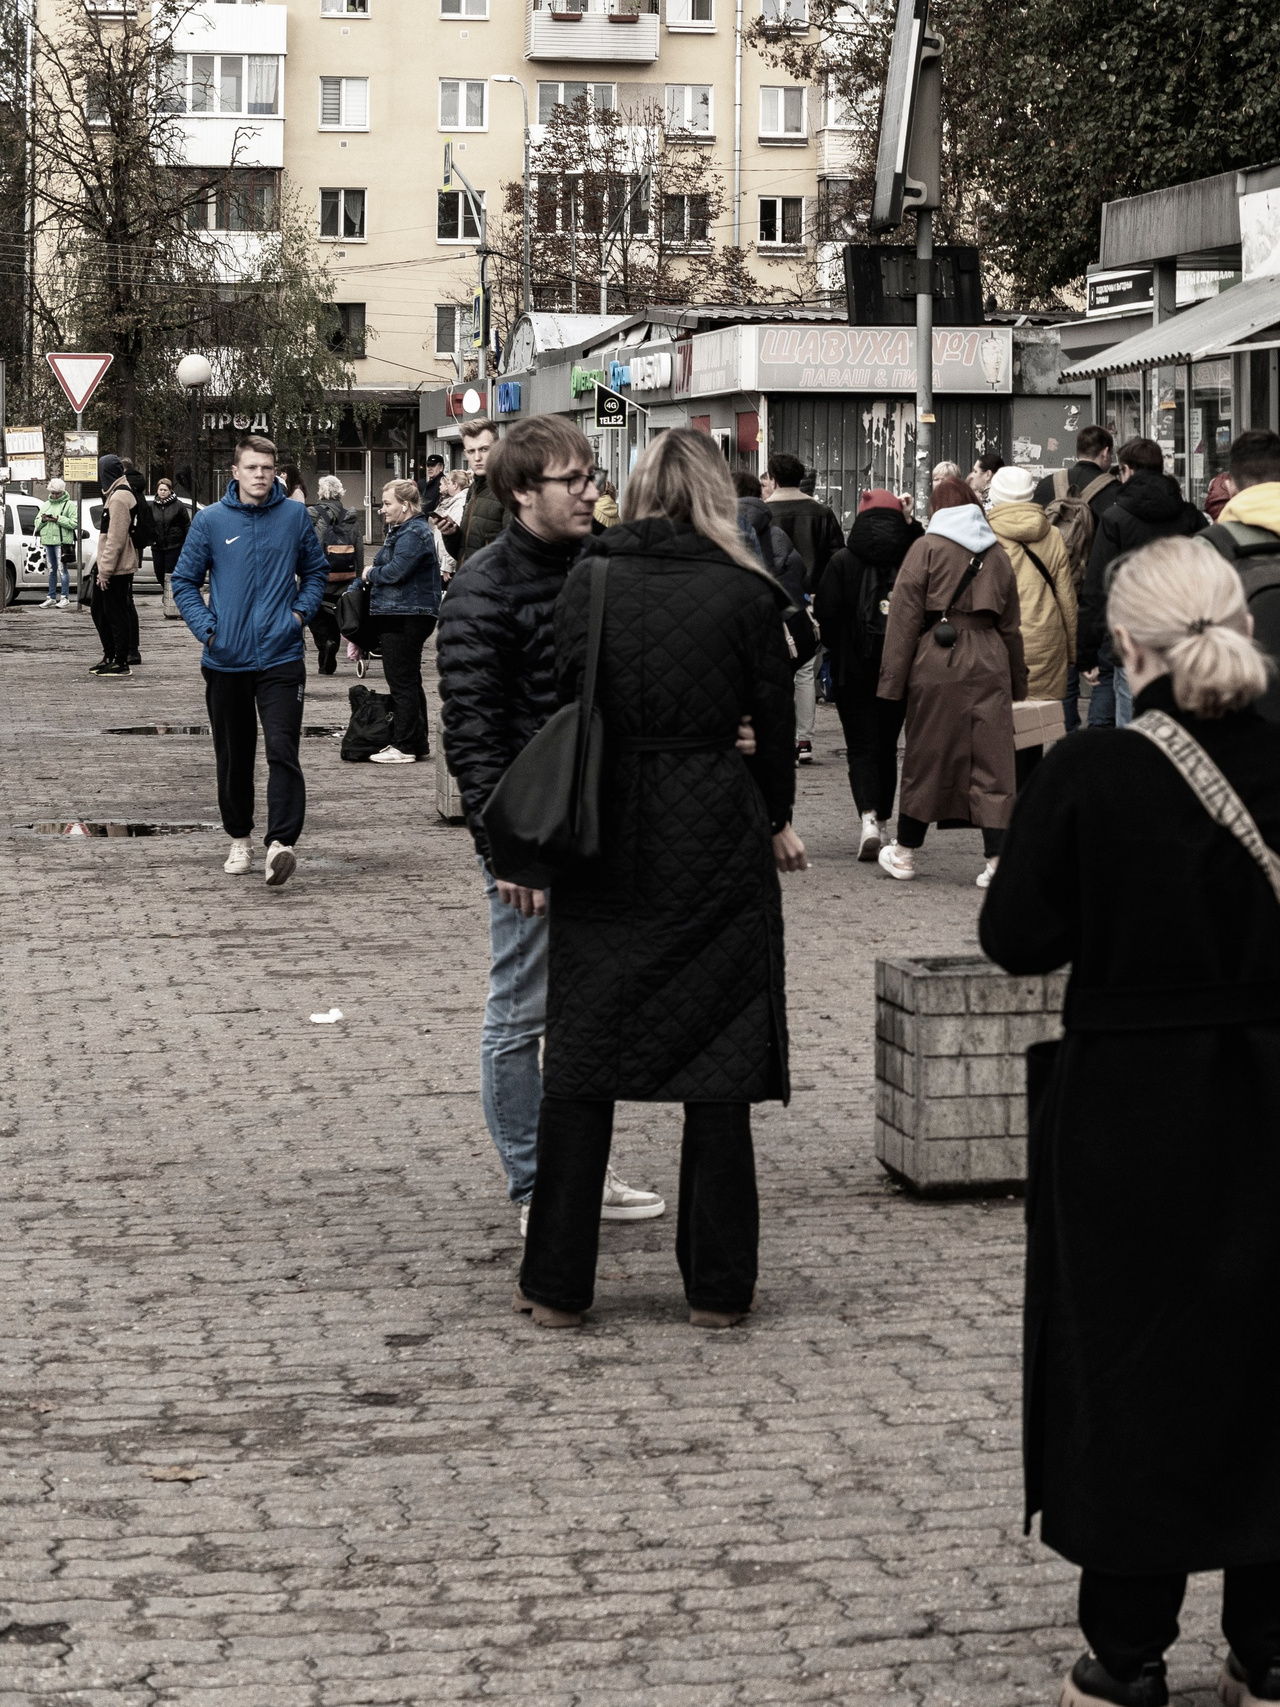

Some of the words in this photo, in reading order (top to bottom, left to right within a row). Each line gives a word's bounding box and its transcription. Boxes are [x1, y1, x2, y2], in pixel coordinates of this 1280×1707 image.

[760, 329, 909, 366] ШАВУХА
[799, 368, 871, 388] ЛАВАШ
[874, 368, 888, 388] &
[891, 368, 943, 388] ПИА
[606, 402, 617, 410] 4G
[202, 412, 336, 433] ПРОДКТЫ
[599, 415, 624, 425] TELE2
